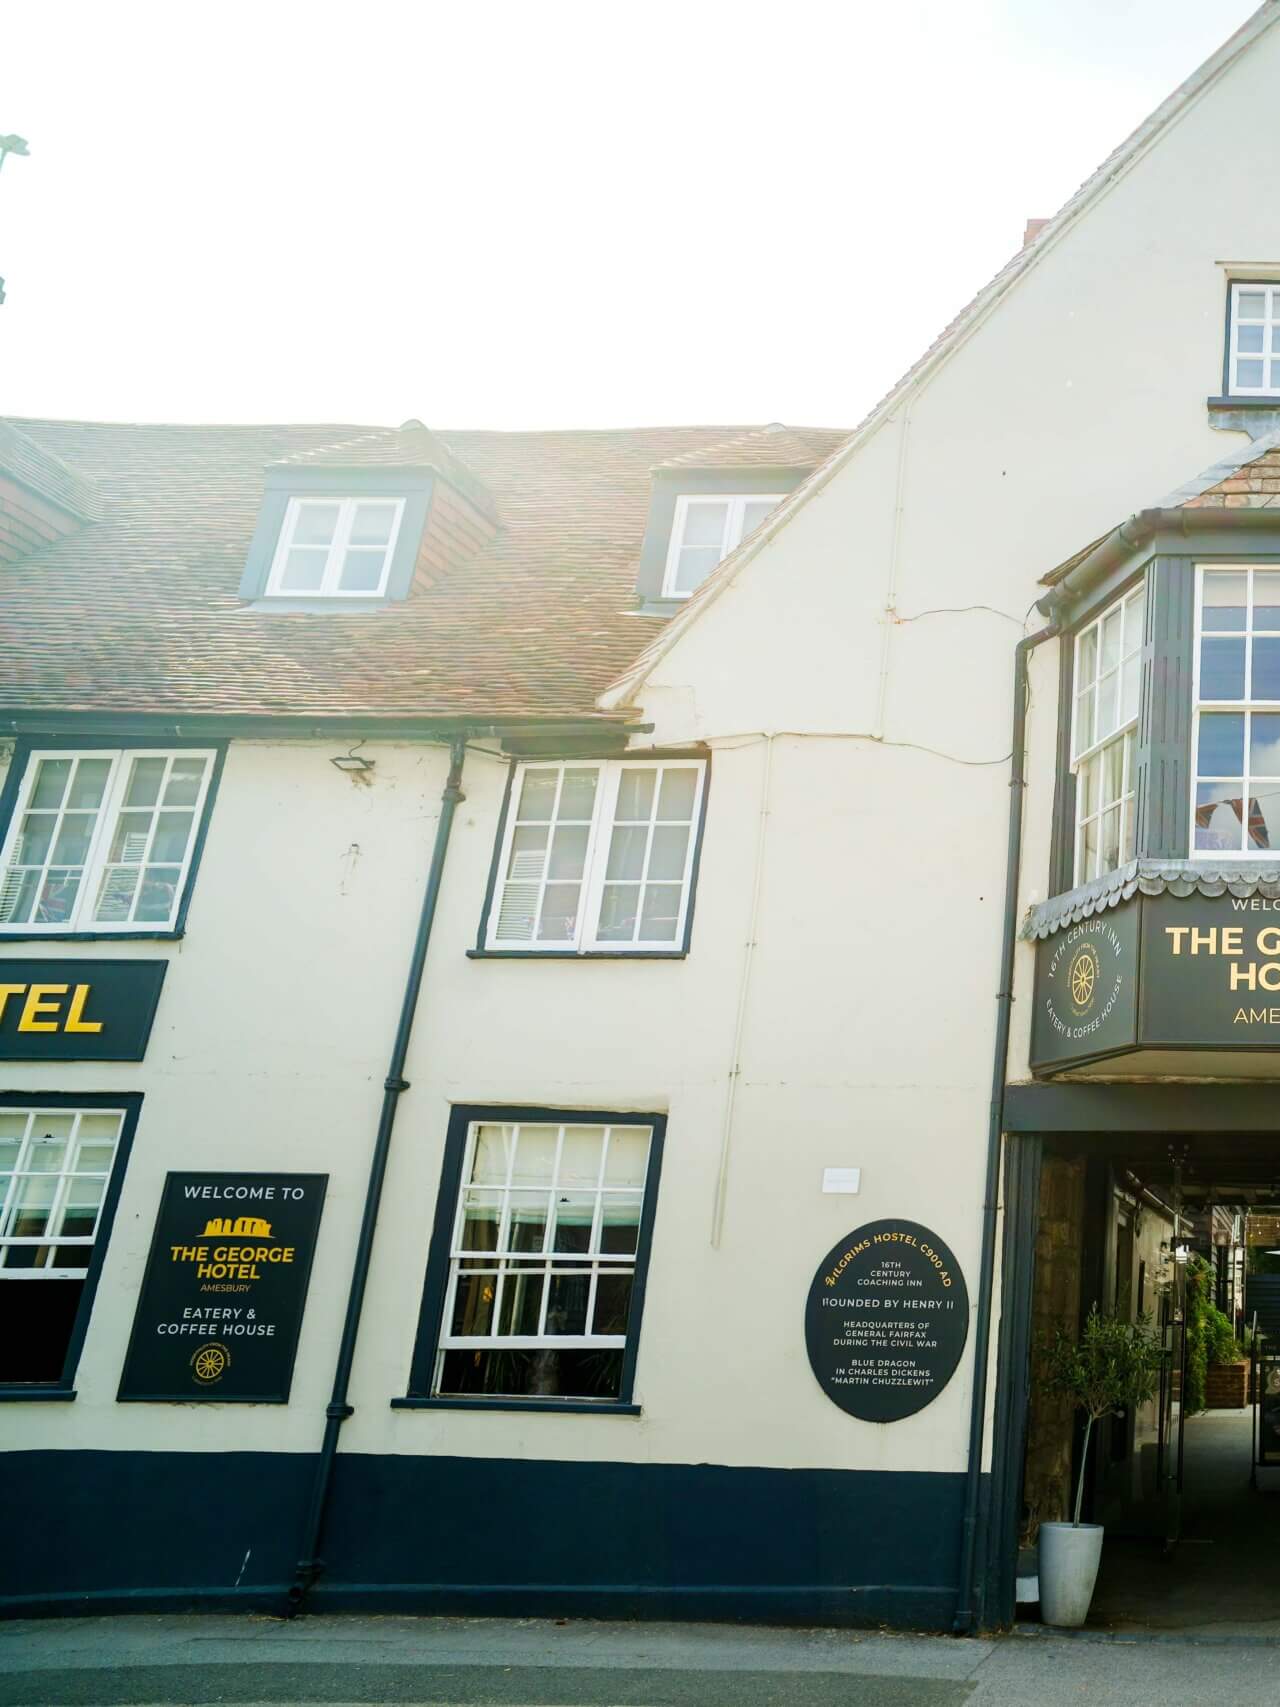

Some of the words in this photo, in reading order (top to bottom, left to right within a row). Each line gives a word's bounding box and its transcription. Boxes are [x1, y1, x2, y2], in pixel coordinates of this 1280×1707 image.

[1165, 927, 1244, 955] THE
[1048, 942, 1067, 978] 16TH
[1067, 920, 1107, 944] CENTURY
[1107, 927, 1122, 957] INN
[0, 984, 103, 1033] TEL
[1046, 998, 1065, 1036] EATERY
[1066, 1028, 1071, 1038] &
[1073, 1018, 1101, 1039] COFFEE
[1101, 975, 1123, 1021] HOUSE
[184, 1185, 276, 1200] WELCOME
[282, 1187, 305, 1200] TO
[170, 1246, 209, 1262] THE
[213, 1247, 295, 1263] GEORGE
[873, 1232, 917, 1247] HOSTEL
[939, 1270, 952, 1288] AD
[881, 1261, 901, 1269] 16TH
[197, 1263, 261, 1279] HOTEL
[870, 1270, 911, 1278] CENTURY
[857, 1278, 904, 1287] COACHING
[906, 1279, 923, 1287] INN
[200, 1284, 251, 1293] AMESBURY
[884, 1299, 900, 1308] BY
[903, 1299, 943, 1309] HENRY
[183, 1307, 243, 1319] EATERY
[246, 1308, 257, 1319] &
[157, 1323, 218, 1335] COFFEE
[222, 1324, 276, 1336] HOUSE
[843, 1320, 915, 1330] HEADQUARTERS
[845, 1329, 887, 1338] GENERAL
[889, 1330, 926, 1339] FAIRFAX
[833, 1338, 868, 1346] DURING
[870, 1339, 888, 1347] THE
[890, 1339, 914, 1347] CIVIL
[916, 1340, 937, 1348] WAR
[851, 1359, 875, 1367] BLUE
[877, 1359, 916, 1368] DRAGON
[835, 1367, 846, 1375] IN
[848, 1368, 889, 1376] CHARLES
[891, 1369, 931, 1377] DICKENS
[831, 1376, 869, 1385] "MARTIN
